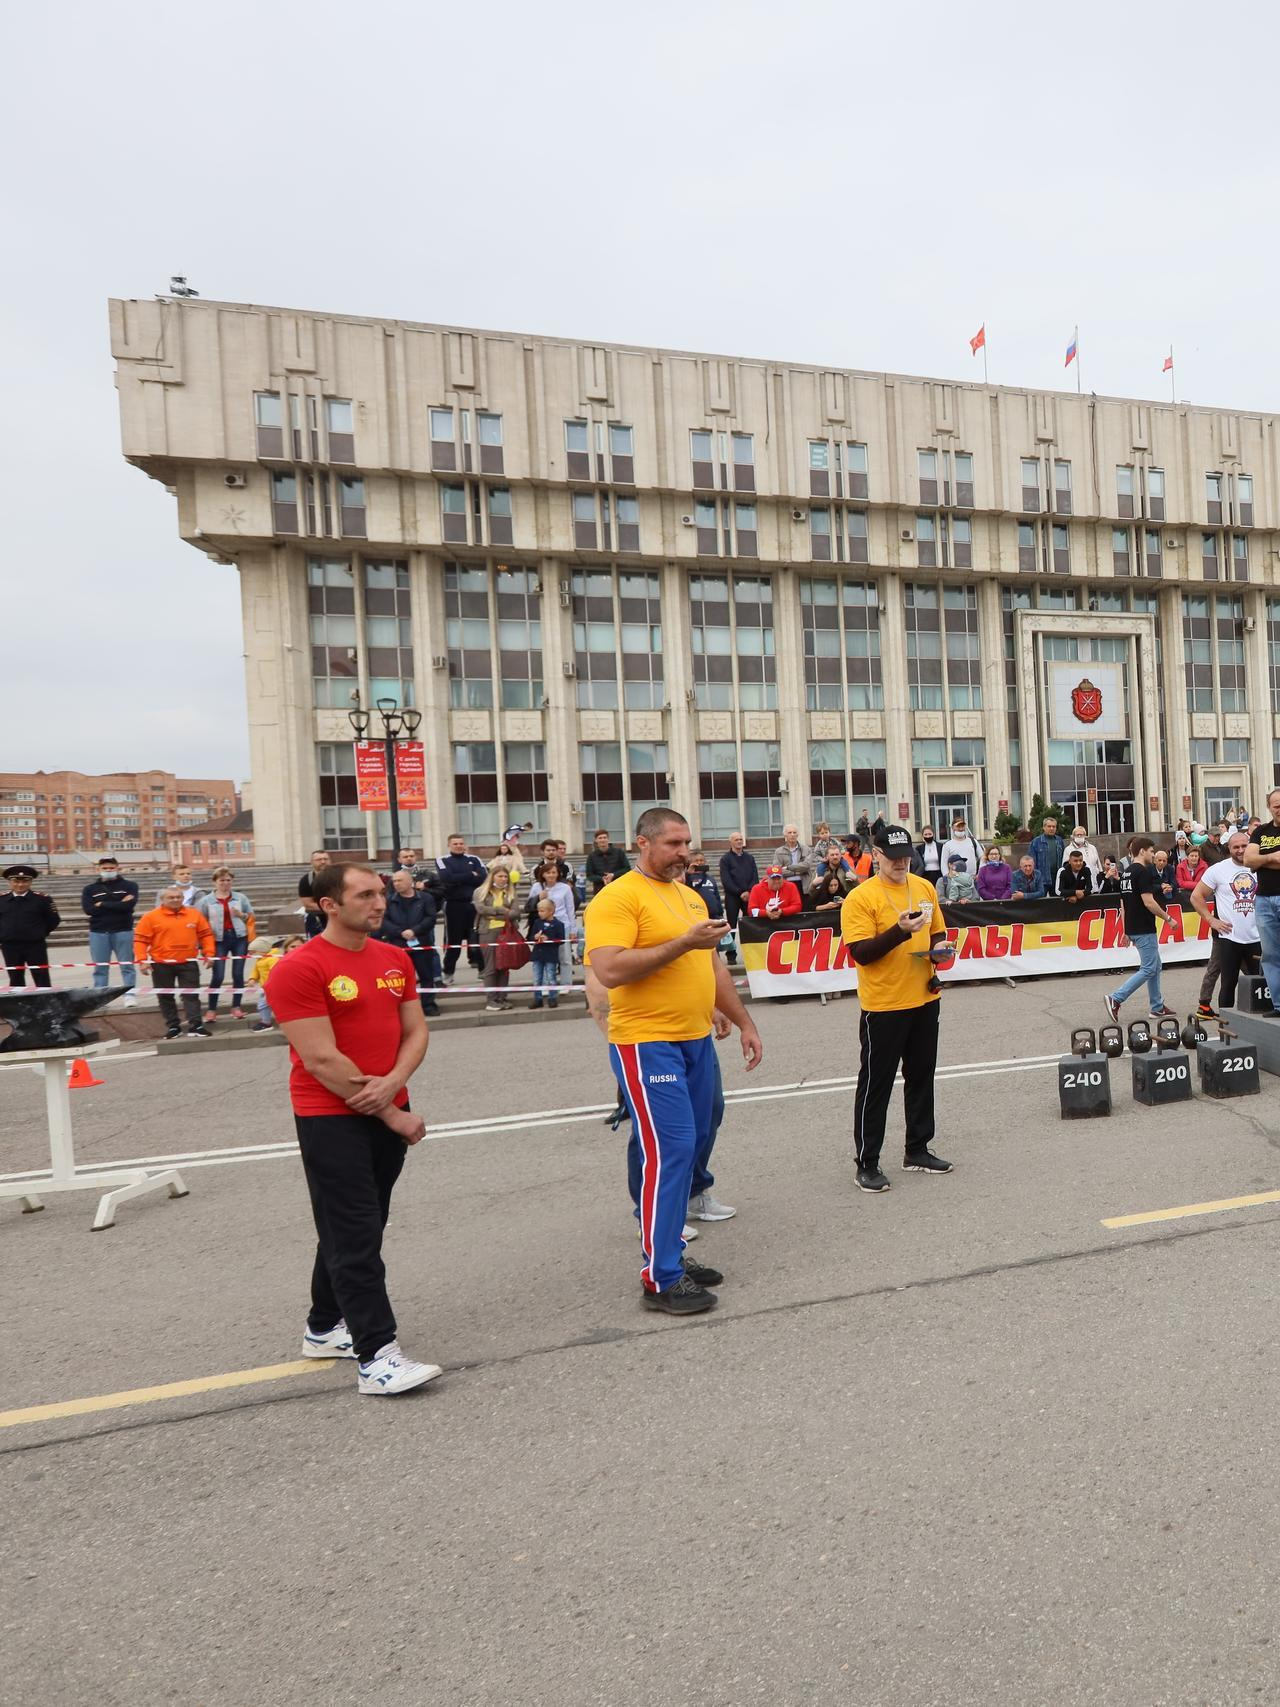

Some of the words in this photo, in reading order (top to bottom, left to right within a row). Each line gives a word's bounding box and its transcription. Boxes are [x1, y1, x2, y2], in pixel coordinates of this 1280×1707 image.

[1077, 904, 1186, 950] СИА
[1138, 1032, 1148, 1041] 32
[1194, 1033, 1205, 1041] 40
[1222, 1056, 1255, 1073] 220
[649, 1074, 678, 1084] RUSSIA
[1063, 1071, 1102, 1088] 240
[1155, 1065, 1187, 1084] 200
